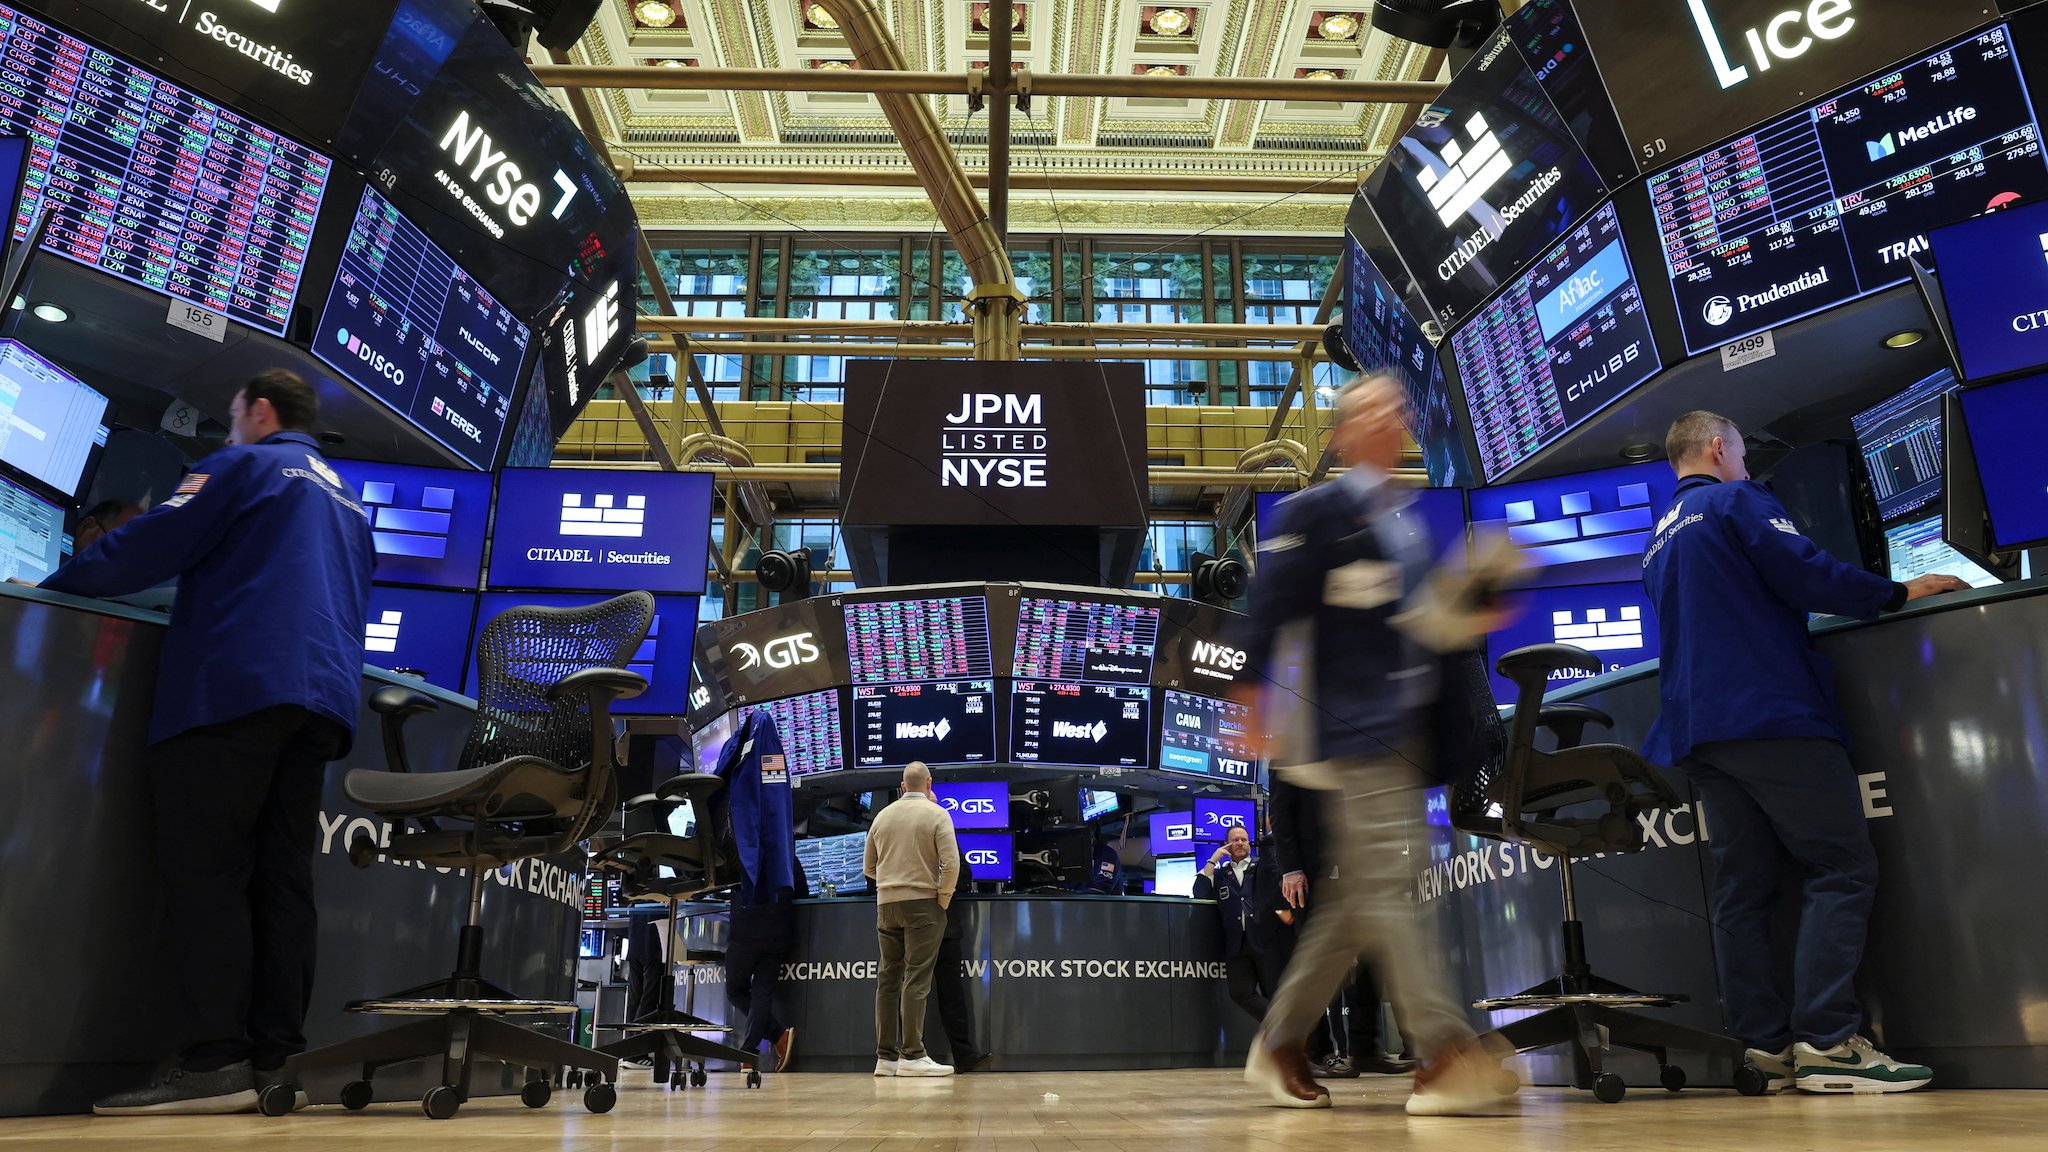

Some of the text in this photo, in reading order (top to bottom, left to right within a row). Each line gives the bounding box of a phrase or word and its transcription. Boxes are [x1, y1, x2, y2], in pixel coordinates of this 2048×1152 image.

[20, 16, 46, 34] CBNA
[16, 27, 39, 42] CBT
[1977, 29, 2002, 46] 78.68
[13, 38, 36, 54] CBZ
[195, 11, 312, 86] Securities
[1982, 45, 2008, 60] 78.31
[10, 50, 36, 66] CHGG
[92, 50, 114, 66] ERO
[1927, 50, 1951, 68] 78.53
[6, 60, 30, 76] COPL
[88, 61, 112, 76] EVAC
[1931, 67, 1956, 82] 78.88
[0, 81, 25, 98] COSO
[1870, 72, 1902, 92] 78.5900
[158, 82, 180, 98] GNK
[1883, 88, 1906, 103] 78.70
[78, 92, 100, 107] EVTL
[156, 93, 178, 106] GROV
[1817, 100, 1838, 114] MET
[75, 103, 96, 118] EXK
[152, 102, 176, 117] HAFN
[220, 110, 240, 124] MAIN
[1833, 108, 1860, 124] 74,350
[218, 121, 239, 135] MATX
[1898, 106, 1977, 146] MetLife
[142, 132, 163, 146] HIPO
[214, 130, 234, 145] MSB
[2002, 126, 2033, 144] 280.69
[140, 143, 160, 156] HLLY
[278, 138, 298, 152] PEW
[2006, 142, 2038, 160] 279.69
[58, 156, 78, 170] FSS
[136, 153, 157, 166] HPP
[208, 150, 230, 164] NOTE
[1703, 152, 1720, 164] USB
[1950, 147, 1980, 164] 280.40
[133, 164, 156, 177] HSHP
[206, 160, 228, 174] NRDY
[1706, 158, 1728, 172] UWMC
[1954, 162, 1984, 180] 281.48
[54, 166, 80, 181] FUBO
[203, 170, 222, 184] NUE
[434, 170, 450, 186] AN
[1651, 173, 1670, 186] RYAN
[1708, 170, 1727, 182] VOYA
[1890, 166, 1930, 188] 280.6300
[50, 178, 76, 192] GATX
[1654, 185, 1668, 195] SBSI
[1710, 180, 1731, 192] WCN
[1904, 182, 1934, 199] 281.29
[48, 189, 72, 202] GCTS
[197, 190, 220, 205] NXDR
[264, 186, 282, 200] RBA
[1656, 192, 1674, 204] SMBK
[1713, 190, 1729, 201] WM
[1842, 192, 1863, 207] TRV
[124, 196, 145, 209] JENA
[194, 200, 214, 216] ODC
[1659, 203, 1674, 214] SSB
[1716, 199, 1736, 212] WSO
[1859, 200, 1886, 216] 49,630
[190, 212, 212, 225] ODV
[258, 206, 276, 220] RRX
[1661, 212, 1676, 224] TFC
[1808, 204, 1834, 220] 117.17
[116, 217, 140, 230] JOBY
[188, 221, 209, 234] ONTF
[256, 216, 274, 230] SKE
[1438, 166, 1561, 280] CITADEL Securities
[1663, 222, 1678, 232] TFIN
[1765, 221, 1790, 236] 116.90
[1812, 218, 1839, 235] 116.50
[114, 226, 134, 240] KEX
[184, 232, 205, 244] OPY
[252, 226, 274, 238] SMRT
[1665, 232, 1680, 243] TRV
[110, 238, 133, 252] LAW
[250, 236, 268, 247] SPIR
[1668, 241, 1684, 252] UCB
[1717, 237, 1748, 256] 117.0750
[1768, 235, 1795, 252] 117.14
[107, 248, 127, 260] LXP
[178, 252, 200, 266] PAAS
[246, 246, 264, 258] SRL
[1670, 250, 1688, 262] UNM
[1726, 252, 1751, 267] 117.14
[104, 258, 125, 273] LZM
[244, 256, 260, 268] SST
[1674, 260, 1692, 272] PRU
[172, 272, 192, 286] PDS
[242, 266, 260, 278] TDS
[341, 271, 356, 286] LAW
[1688, 268, 1712, 282] 28,332
[240, 276, 256, 288] TEX
[1736, 266, 1830, 313] Prudential
[168, 284, 190, 296] SKYH
[1560, 270, 1600, 314] Aflac
[234, 296, 252, 310] TSQ
[186, 308, 212, 326] 155
[459, 326, 500, 366] NUCOR
[1728, 336, 1764, 357] 2499
[359, 342, 404, 386] DISCO
[1567, 342, 1639, 402] CHUBB
[946, 393, 1042, 424] JPM
[446, 406, 482, 444] TEREX
[943, 434, 1046, 450] LISTED
[942, 458, 1046, 488] NYSE
[527, 548, 670, 564] CITADEL Securities
[764, 632, 820, 668] GTS
[858, 688, 875, 696] WST
[1176, 712, 1201, 729] CAVA
[896, 722, 934, 738] West
[1052, 721, 1092, 738] West
[1218, 758, 1249, 776] YETI
[1418, 861, 1442, 904] NEW
[1444, 846, 1496, 892] YORK
[693, 967, 720, 985] YORK
[992, 960, 1056, 978] YORK
[1060, 960, 1131, 978] STOCK
[1135, 960, 1228, 980] EXCHANGE
